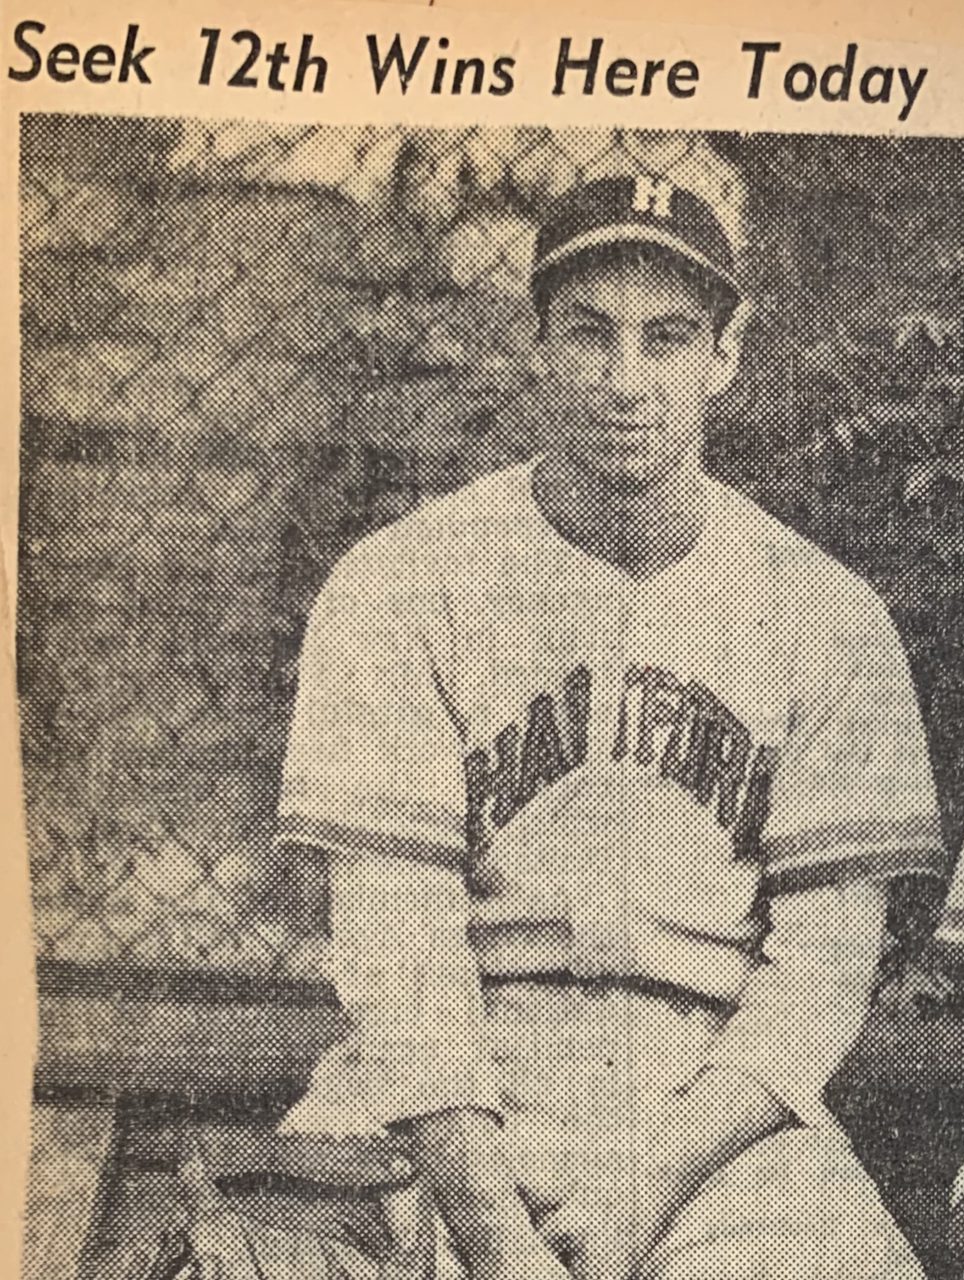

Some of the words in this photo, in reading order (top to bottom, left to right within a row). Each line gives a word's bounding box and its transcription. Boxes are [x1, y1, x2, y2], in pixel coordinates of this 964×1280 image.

[8, 20, 156, 85] Seek
[198, 27, 328, 94] 12th
[366, 33, 516, 97] Wins
[552, 37, 700, 98] Here
[741, 41, 930, 120] Today
[632, 174, 674, 217] H
